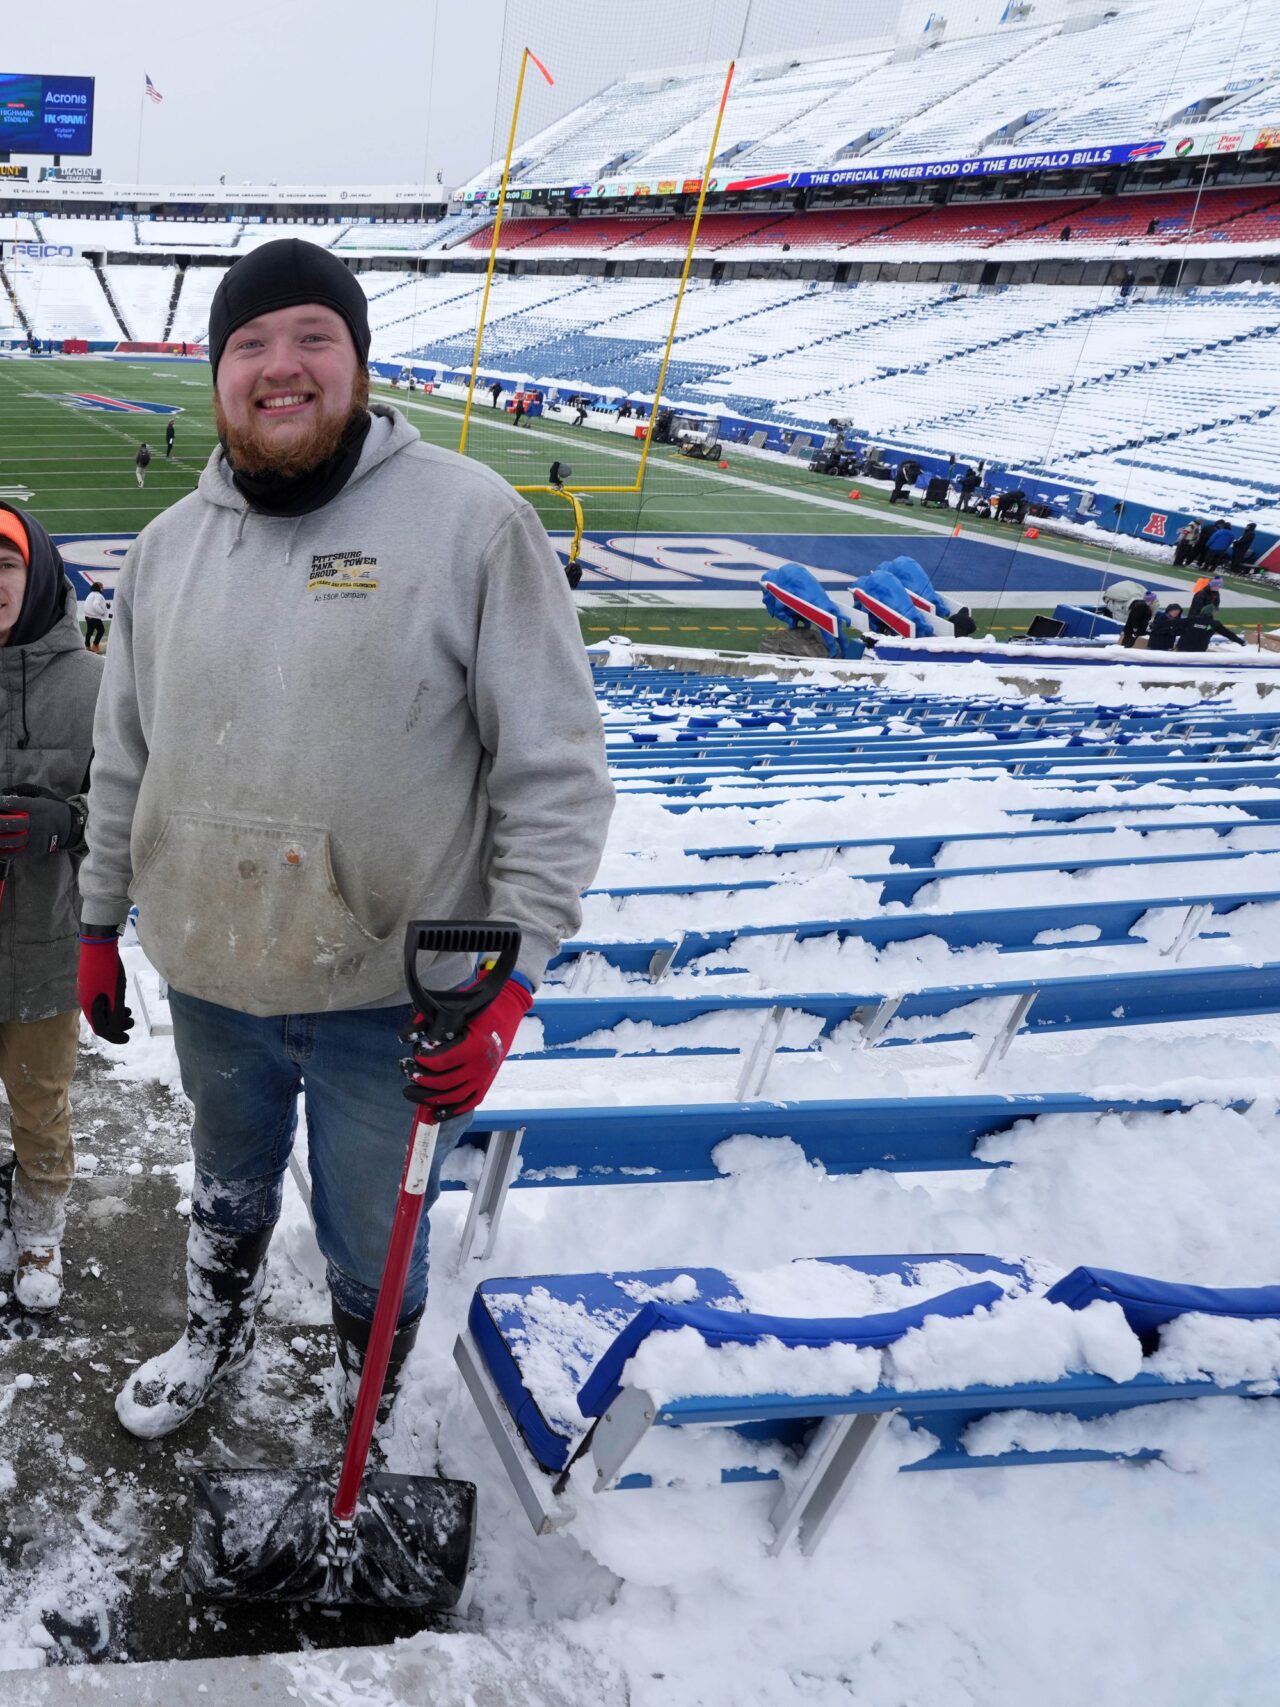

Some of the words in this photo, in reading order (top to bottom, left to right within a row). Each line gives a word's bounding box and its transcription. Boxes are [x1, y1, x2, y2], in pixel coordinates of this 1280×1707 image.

[45, 91, 87, 104] Acronis
[0, 109, 34, 117] HIGHMARK
[60, 168, 98, 176] IMAGINE
[810, 174, 830, 184] THE
[832, 170, 880, 183] OFFICIAL
[882, 166, 924, 179] FINGER
[925, 163, 960, 176] FOOD
[962, 162, 979, 173] OF
[983, 159, 1005, 172] THE
[1008, 153, 1069, 170] BUFFALO
[1072, 149, 1112, 164] BILLS
[505, 191, 520, 199] 0:00
[12, 245, 74, 258] GEICO
[312, 550, 362, 564] PITTSBURG
[311, 561, 334, 572] TANK
[343, 557, 377, 568] TOWER
[309, 569, 338, 580] GROUP
[340, 592, 368, 600] Company
